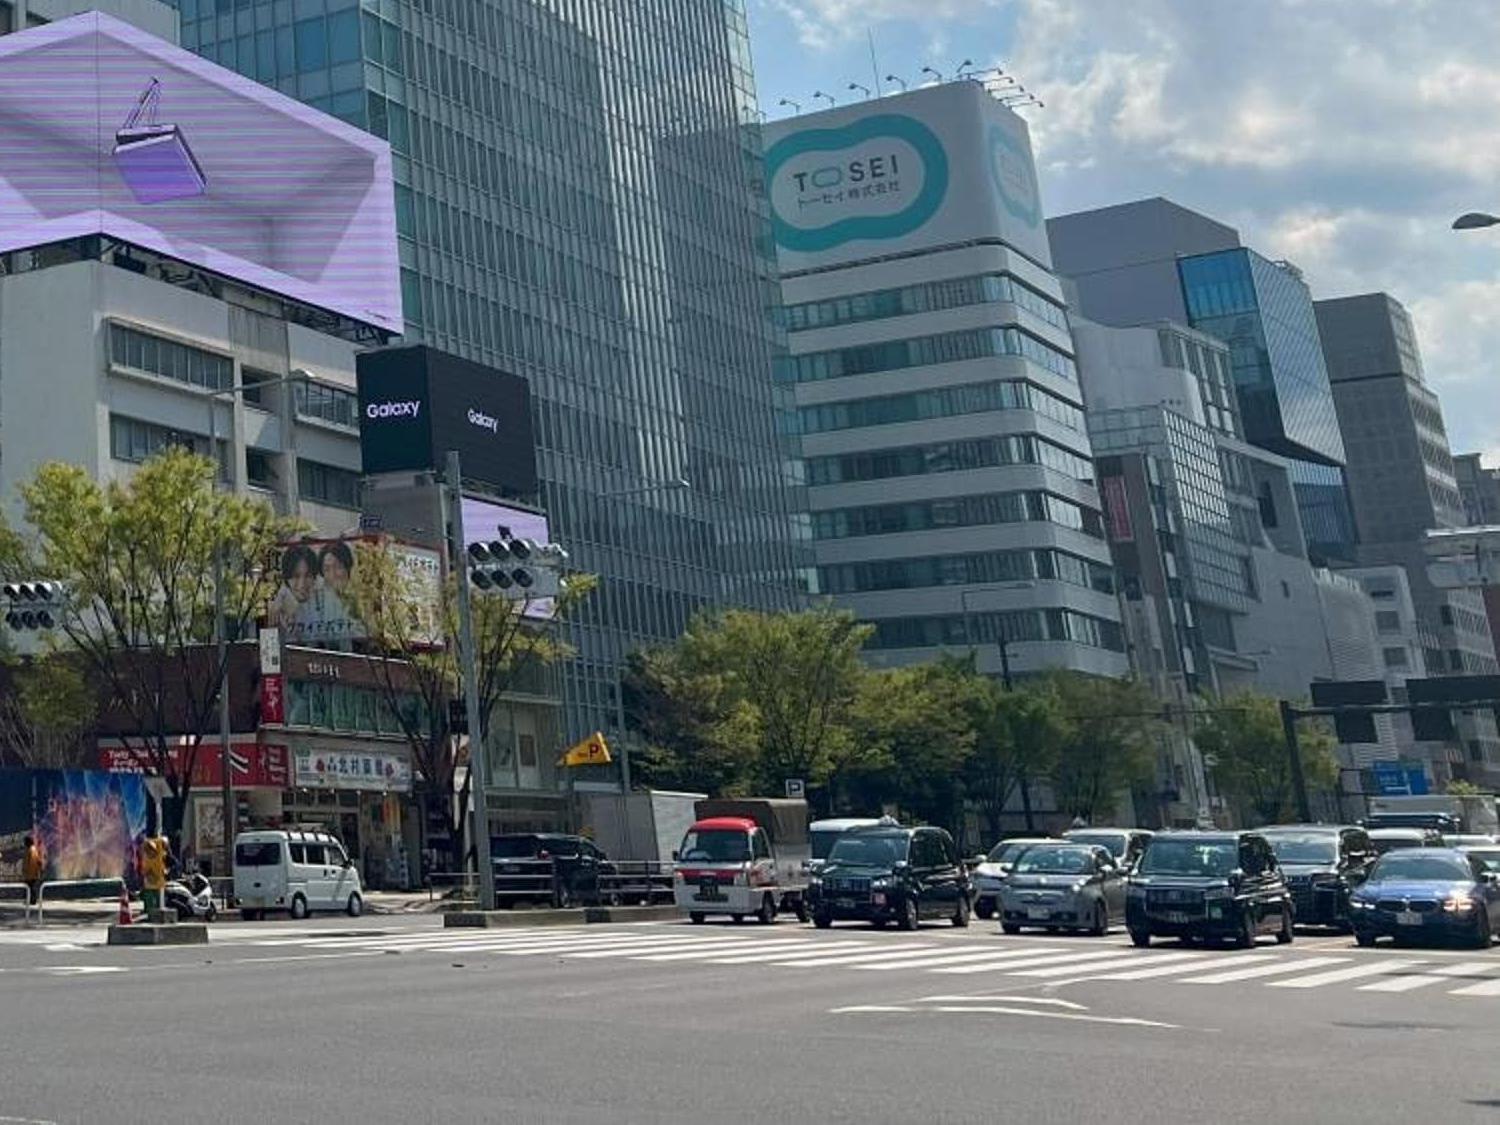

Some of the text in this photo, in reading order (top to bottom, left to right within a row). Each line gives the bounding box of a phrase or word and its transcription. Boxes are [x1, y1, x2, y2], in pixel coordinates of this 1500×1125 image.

[793, 154, 898, 192] TOSEI
[367, 401, 420, 418] Galaxy
[467, 408, 499, 433] Galaxy
[589, 743, 599, 759] P
